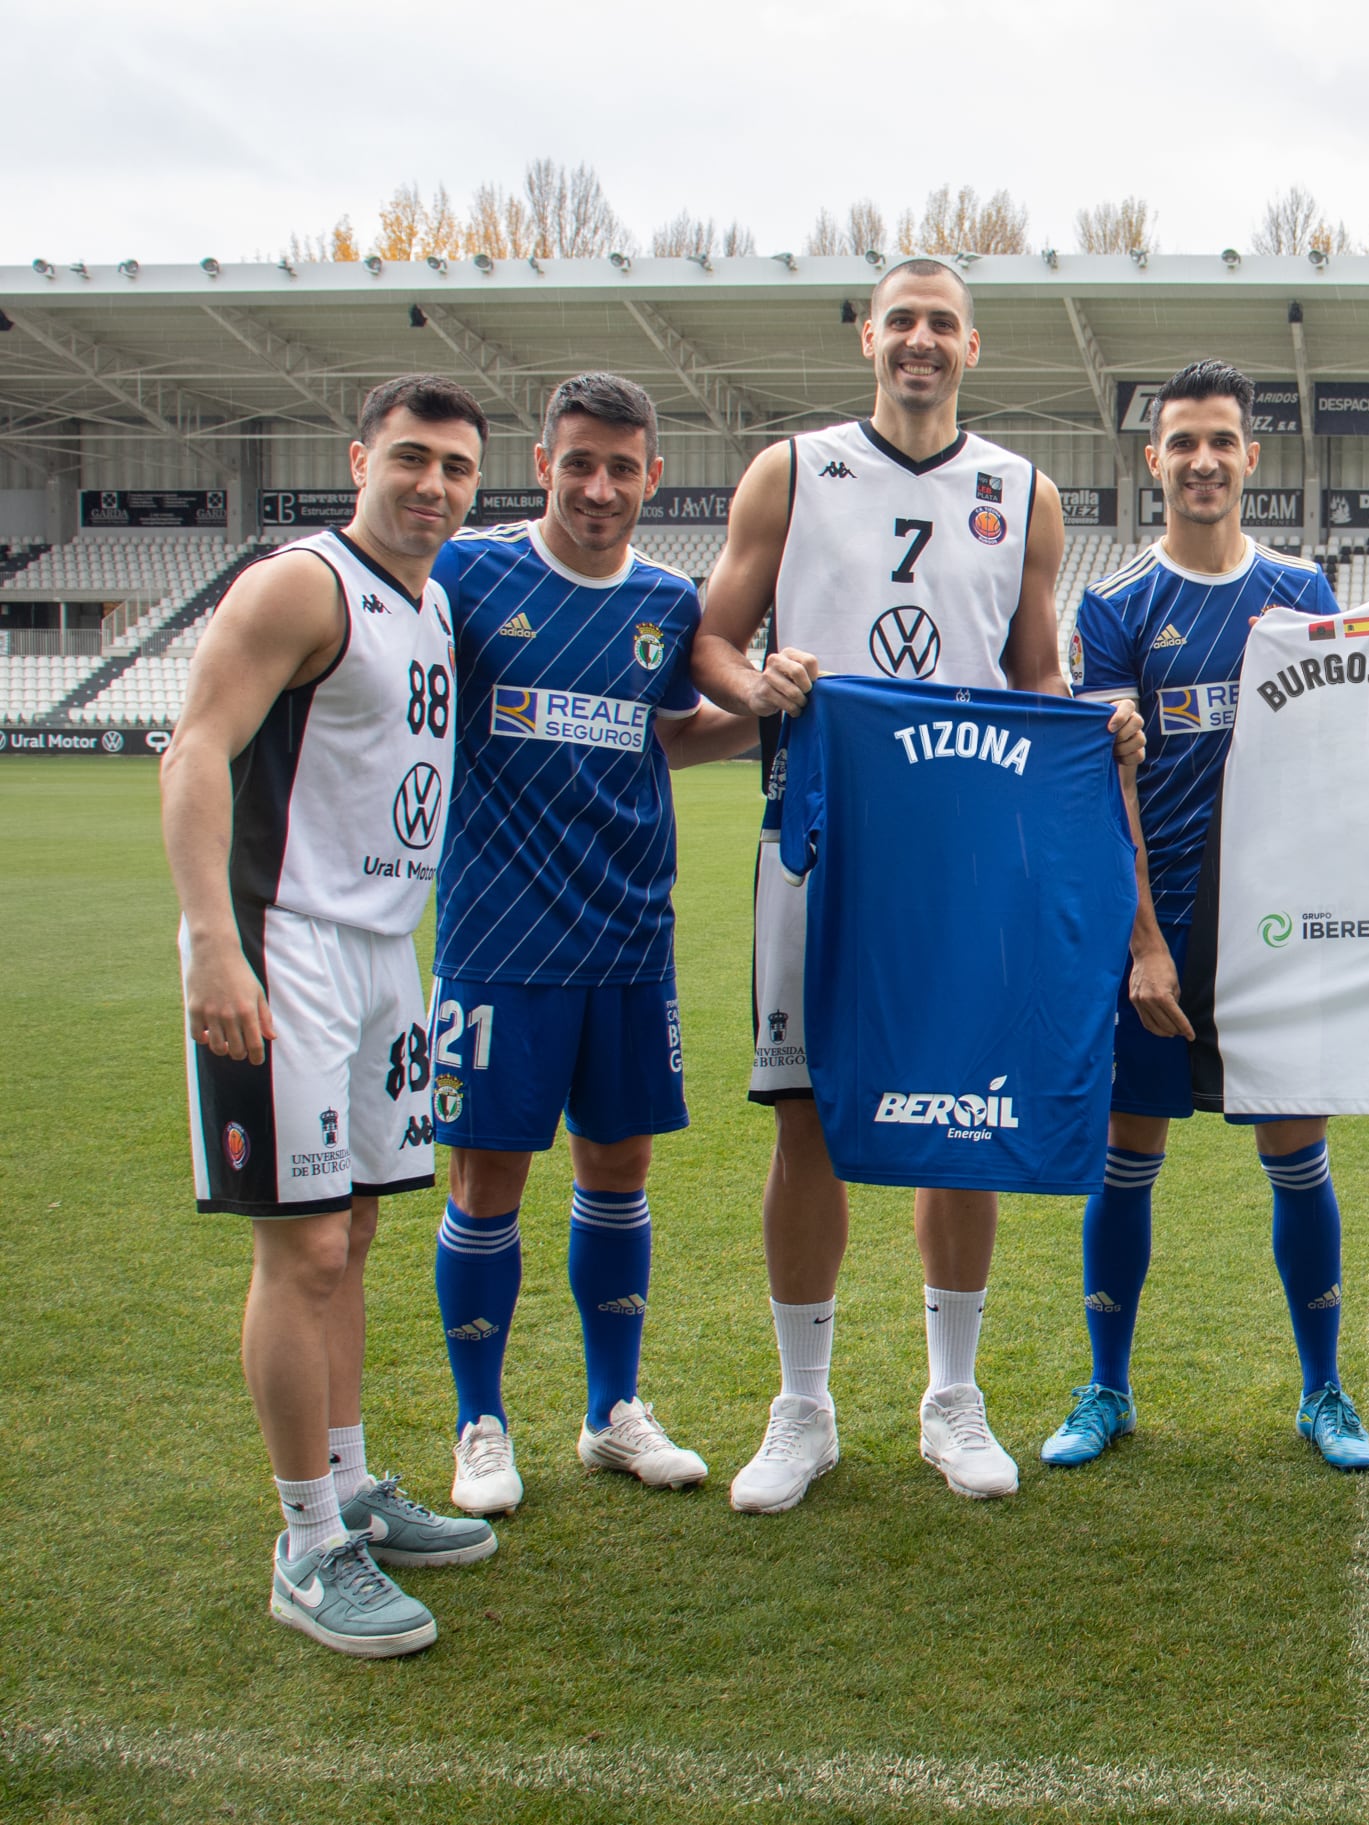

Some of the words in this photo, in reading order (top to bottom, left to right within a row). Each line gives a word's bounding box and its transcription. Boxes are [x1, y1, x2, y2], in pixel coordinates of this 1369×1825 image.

[1256, 393, 1298, 404] ARIDOS
[483, 496, 545, 507] METALBUR
[640, 506, 664, 517] ICOS
[891, 518, 933, 583] 7
[500, 627, 537, 639] adidas
[1153, 637, 1187, 649] adidas
[408, 660, 450, 738] 88
[547, 693, 647, 728] REALE
[11, 733, 45, 748] Ural
[48, 734, 97, 748] Motor
[545, 721, 642, 748] SEGUROS
[894, 721, 1031, 776] TIZONA
[364, 856, 400, 877] Ural
[408, 860, 437, 880] Motor
[1302, 912, 1332, 920] GRUPO
[436, 999, 494, 1069] 21
[760, 1055, 806, 1067] BURGO
[947, 1128, 992, 1142] Energía
[291, 1149, 350, 1165] UNIVERSIDA
[292, 1167, 309, 1177] DE
[312, 1158, 351, 1176] BURGO
